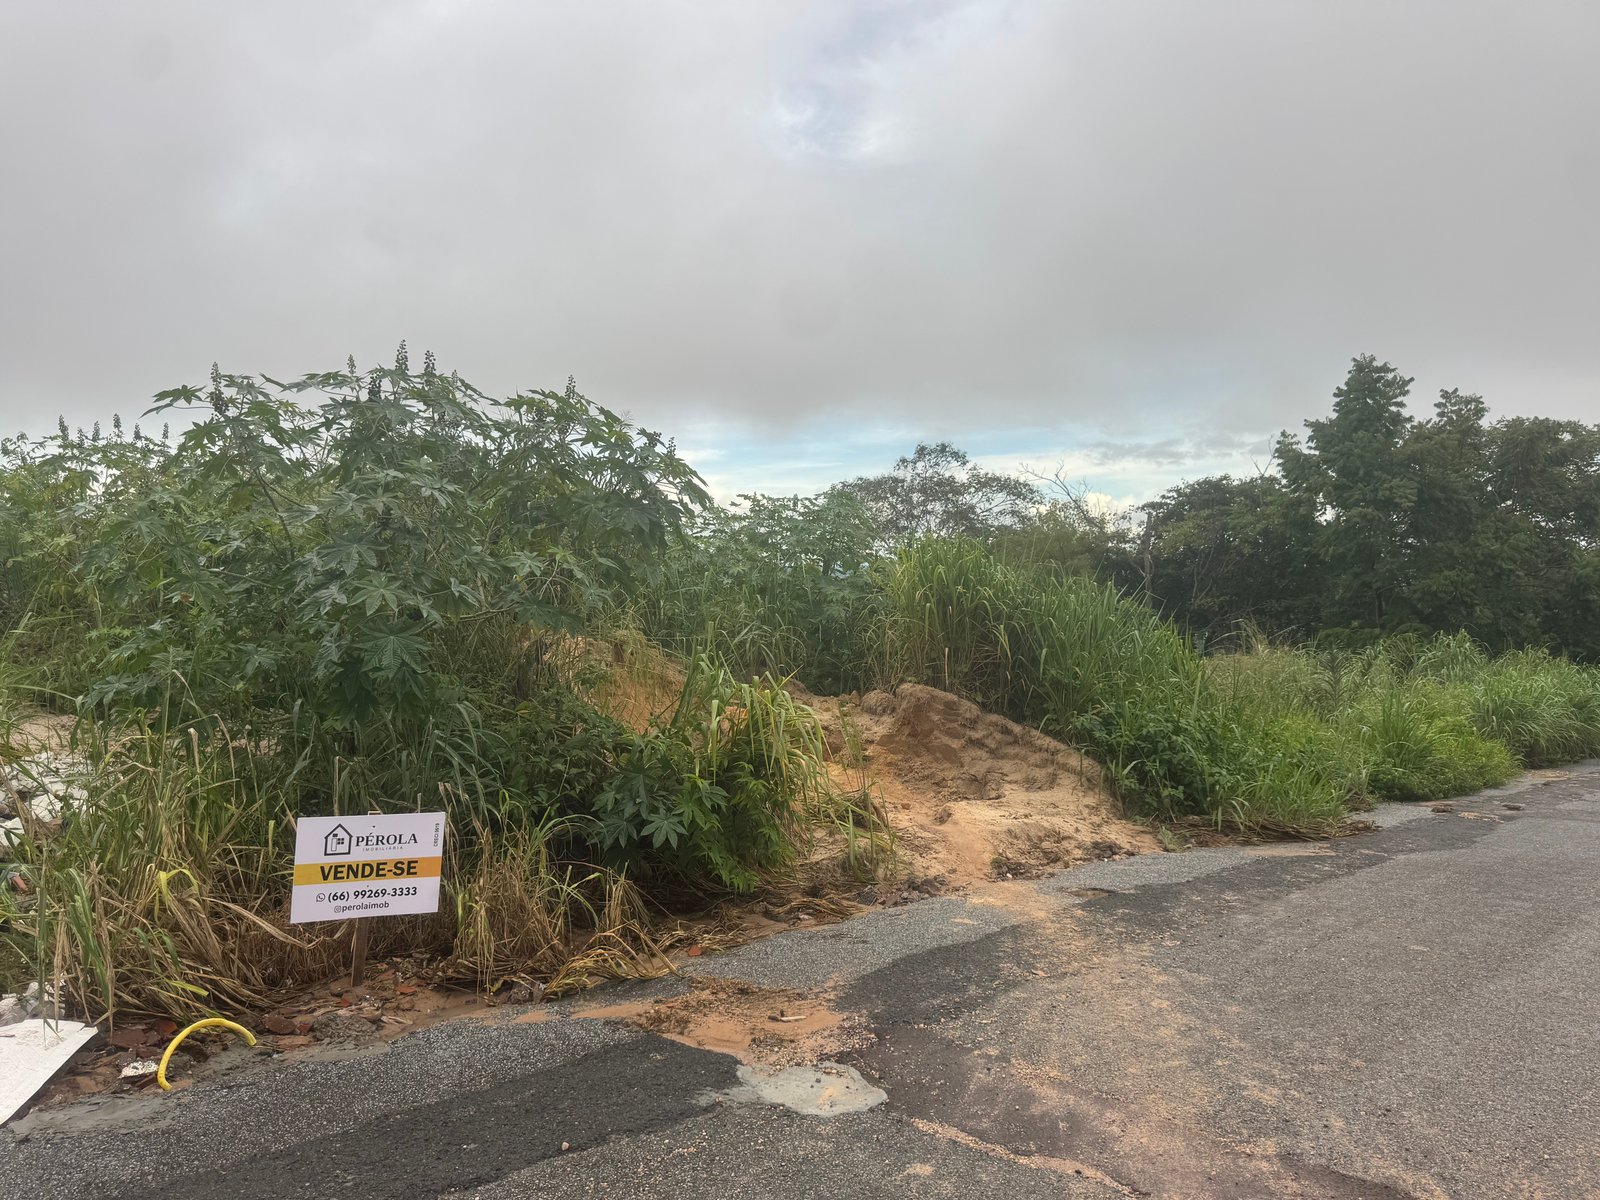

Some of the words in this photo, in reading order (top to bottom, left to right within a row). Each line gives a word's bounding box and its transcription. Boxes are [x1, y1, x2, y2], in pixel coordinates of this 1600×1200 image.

[355, 832, 418, 847] PÉROLA
[320, 860, 419, 881] VENDE-SE
[328, 891, 350, 903] (66)
[353, 886, 417, 900] 99269-3333
